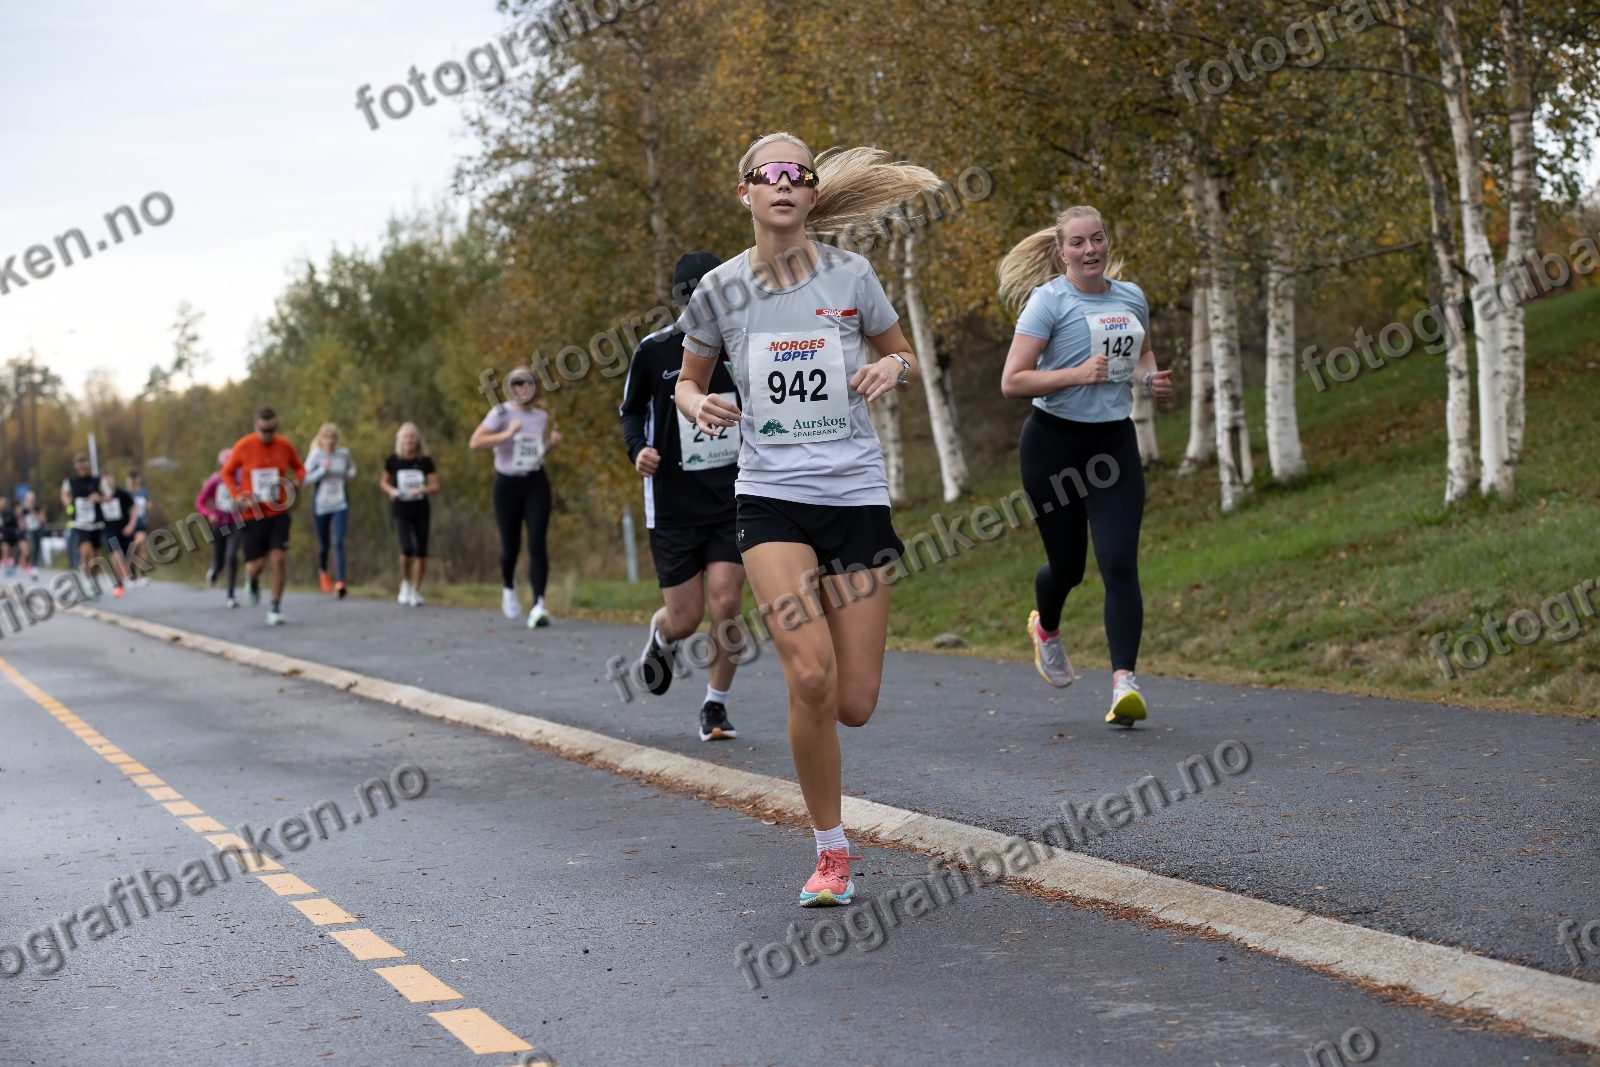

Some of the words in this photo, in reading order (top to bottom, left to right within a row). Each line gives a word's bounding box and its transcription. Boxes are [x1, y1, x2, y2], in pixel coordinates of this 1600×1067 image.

[769, 338, 825, 351] NORGES
[1103, 336, 1133, 357] 142
[774, 350, 817, 362] LØPET
[767, 368, 828, 404] 942
[792, 416, 847, 429] Aurskog
[793, 428, 838, 437] SPAREBANK
